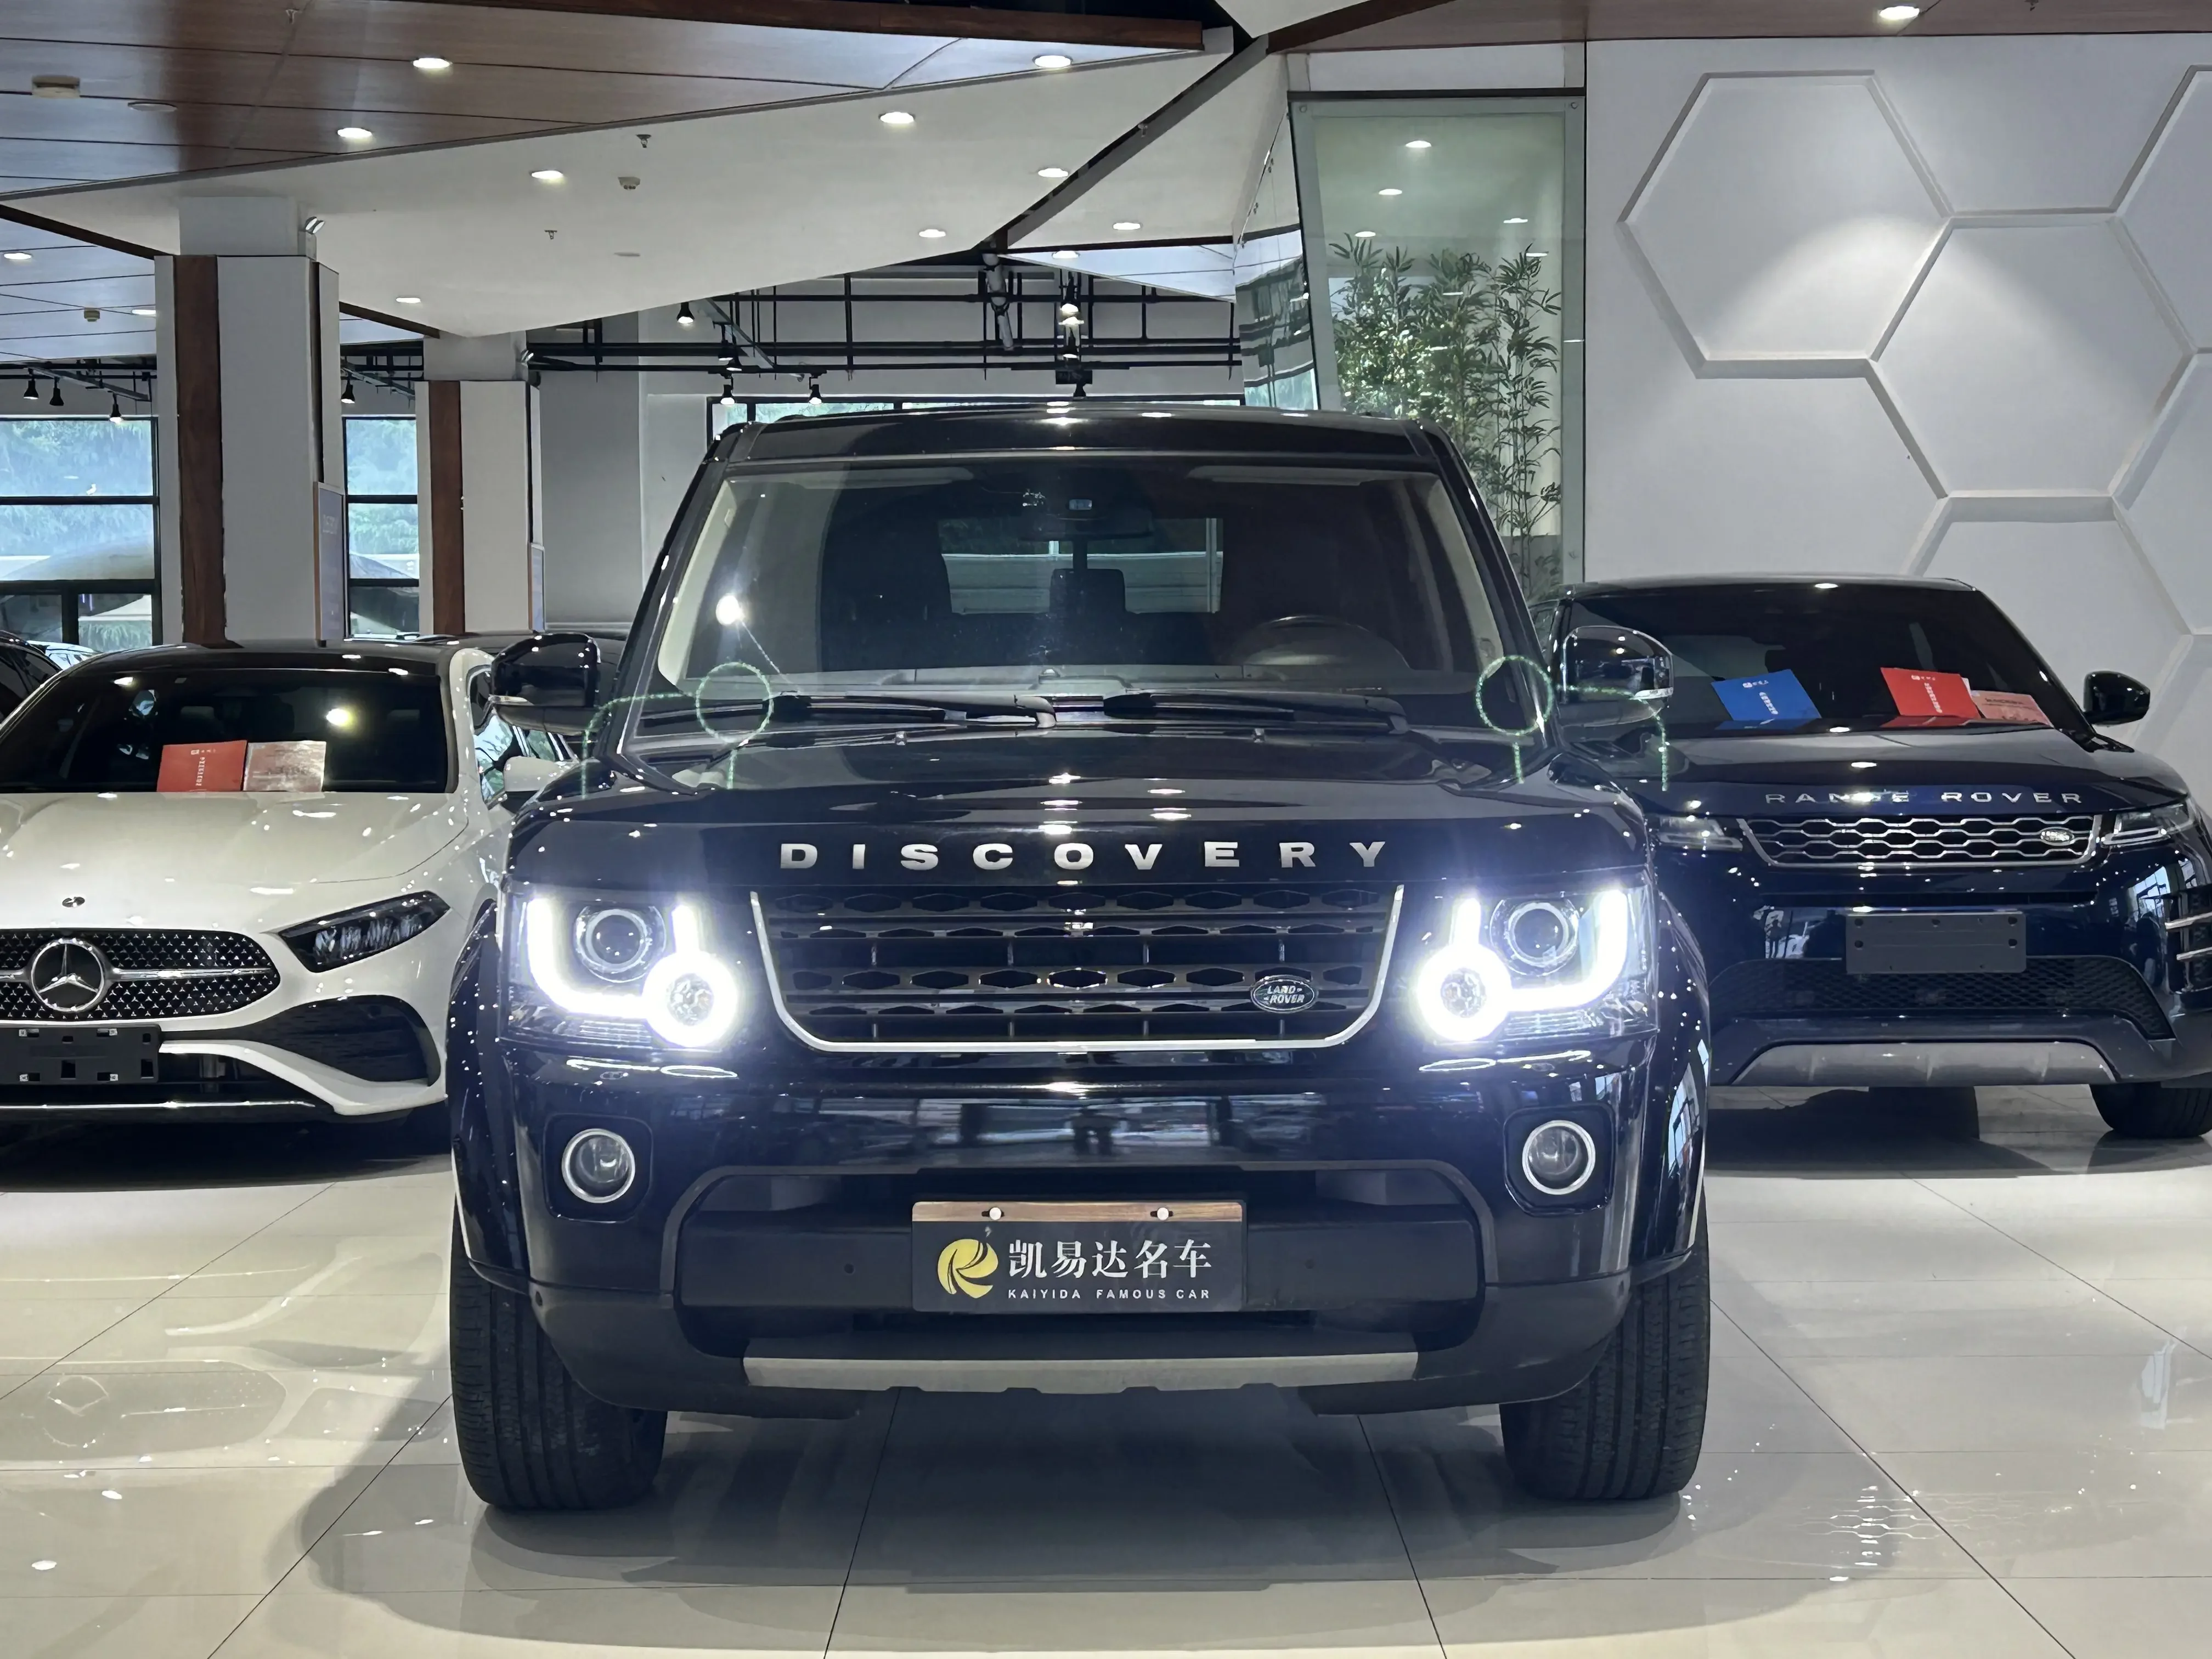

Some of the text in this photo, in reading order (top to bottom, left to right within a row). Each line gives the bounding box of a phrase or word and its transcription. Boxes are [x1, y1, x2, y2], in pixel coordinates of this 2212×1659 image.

[1765, 789, 2083, 804] RANE ROVER
[780, 840, 1386, 870] DISCOVERY
[1267, 985, 1296, 995] LAND
[1269, 994, 1305, 1004] ROVER
[1008, 1238, 1212, 1279] 凯易达名车
[1008, 1289, 1210, 1300] KAIYIDA FAMOUS CAR
